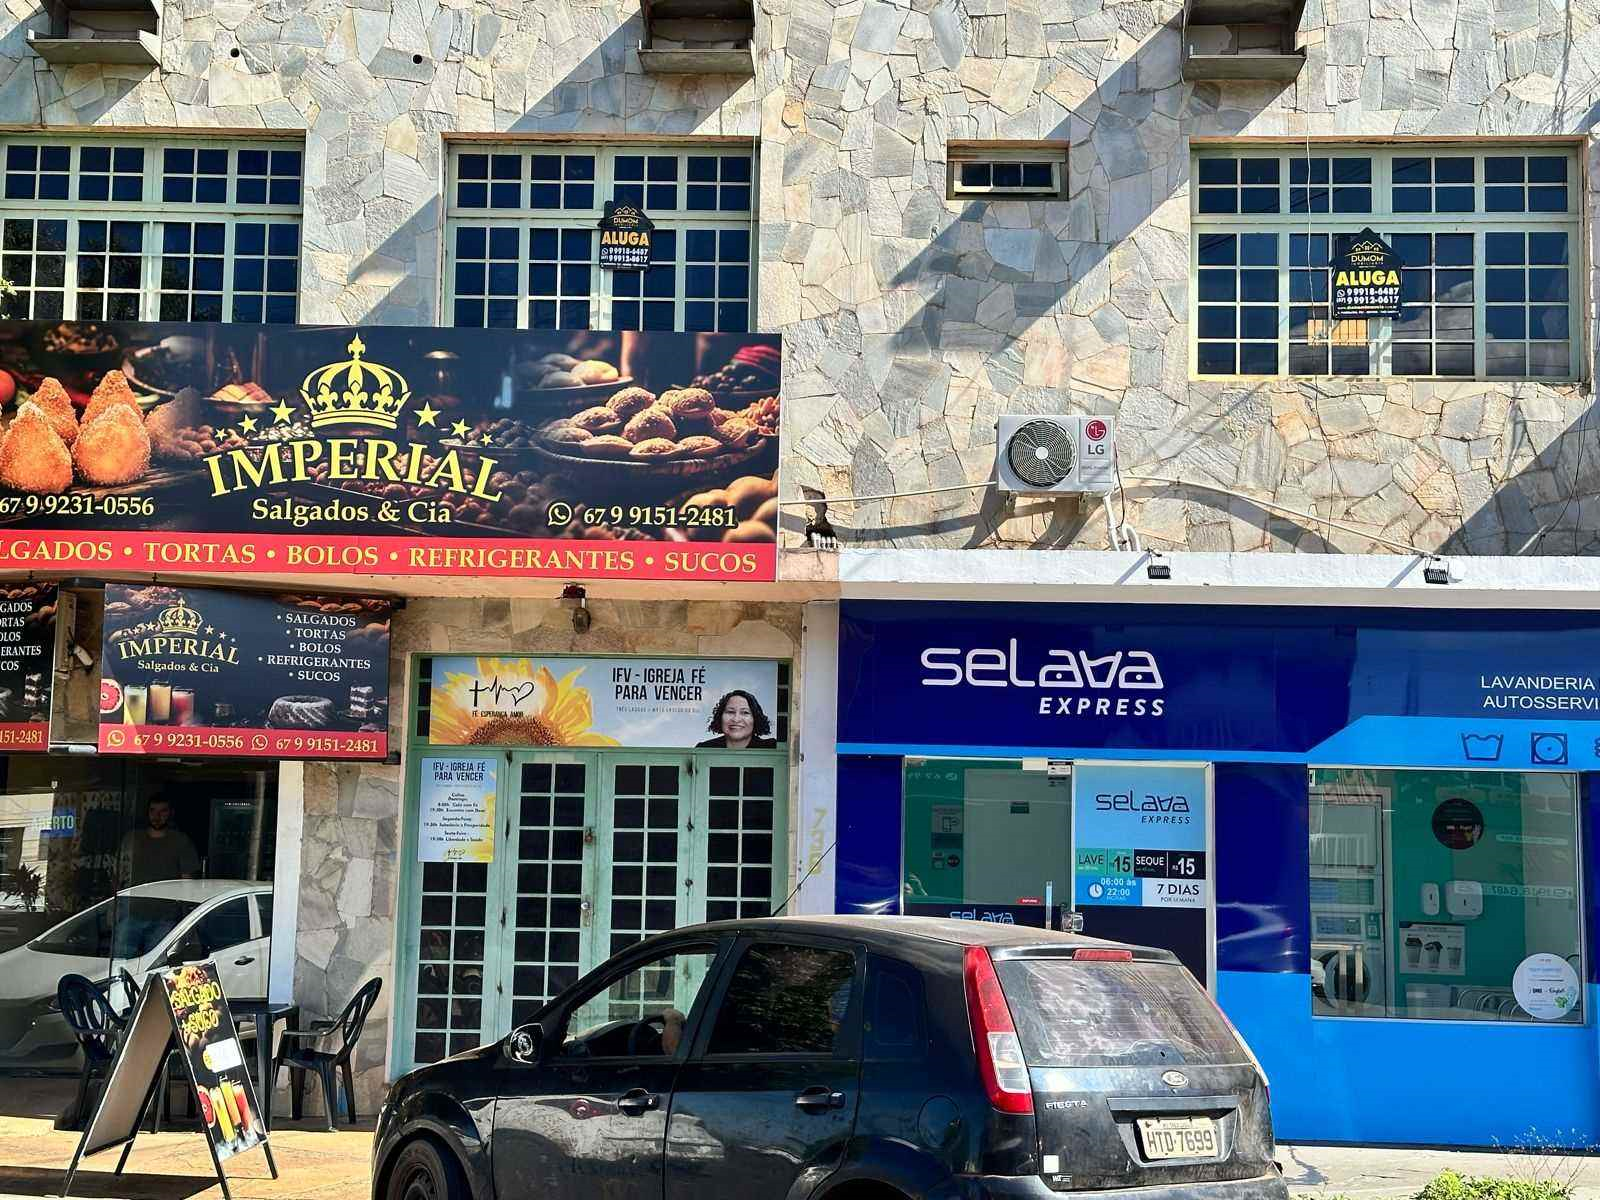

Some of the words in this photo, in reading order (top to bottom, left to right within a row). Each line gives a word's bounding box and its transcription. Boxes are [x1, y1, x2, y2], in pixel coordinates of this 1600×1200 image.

[601, 231, 650, 246] ALUGA
[1351, 255, 1384, 263] DUMOM
[1336, 270, 1400, 287] ALUGA
[1088, 444, 1105, 455] LG
[203, 438, 503, 502] IMPERIAL
[0, 496, 21, 514] 67
[26, 494, 39, 514] 9
[45, 495, 154, 515] 9231-0556
[252, 498, 368, 527] Salgados
[377, 500, 400, 522] &
[408, 501, 451, 523] Cia
[584, 508, 605, 524] 67
[610, 506, 623, 525] 9
[629, 506, 736, 527] 9151-2481
[143, 542, 256, 564] TORTAS
[287, 545, 379, 566] BOLOS
[408, 547, 634, 571] REFRIGERANTES
[664, 552, 757, 573] SUCOS
[0, 602, 33, 613] GADOS
[0, 616, 25, 628] RTAS
[286, 613, 356, 627] SALGADOS
[295, 628, 346, 640] TORTAS
[0, 645, 41, 656] ERANTES
[118, 637, 240, 665] IMPERIAL
[299, 642, 341, 654] BOLOS
[0, 660, 19, 671] COS
[138, 660, 186, 673] Salgados
[189, 662, 199, 672] &
[201, 663, 219, 673] Cia
[267, 655, 371, 669] REFRIGERANTES
[298, 670, 341, 682] SUCOS
[612, 667, 631, 683] IFV
[643, 668, 685, 684] IGREJA
[691, 665, 706, 684] FÉ
[1481, 675, 1596, 690] LAVANDERIA
[615, 685, 647, 700] PARA
[654, 686, 702, 701] VENCER
[1039, 697, 1165, 716] EXPRESS
[134, 735, 150, 746] 67
[154, 733, 163, 746] 9
[167, 734, 244, 748] 9231-0556
[276, 739, 291, 750] 67
[294, 737, 303, 751] 9
[307, 738, 378, 753] 9151-2481
[433, 763, 444, 771] IFV
[450, 763, 474, 772] IGREJA
[477, 761, 485, 772] FÉ
[434, 772, 453, 781] PARA
[456, 773, 484, 781] VENCER
[1141, 815, 1191, 825] EXPRESS
[1078, 855, 1105, 865] LAVE
[1111, 856, 1131, 873] 15
[1135, 856, 1165, 866] SEQUE
[1178, 857, 1195, 876] 15
[1100, 878, 1124, 887] 06:00
[1107, 888, 1130, 897] 22:00
[1157, 884, 1165, 895] 7
[1168, 884, 1200, 896] DIAS
[171, 981, 221, 1009] SALGADO
[1045, 1100, 1087, 1110] FIESTA
